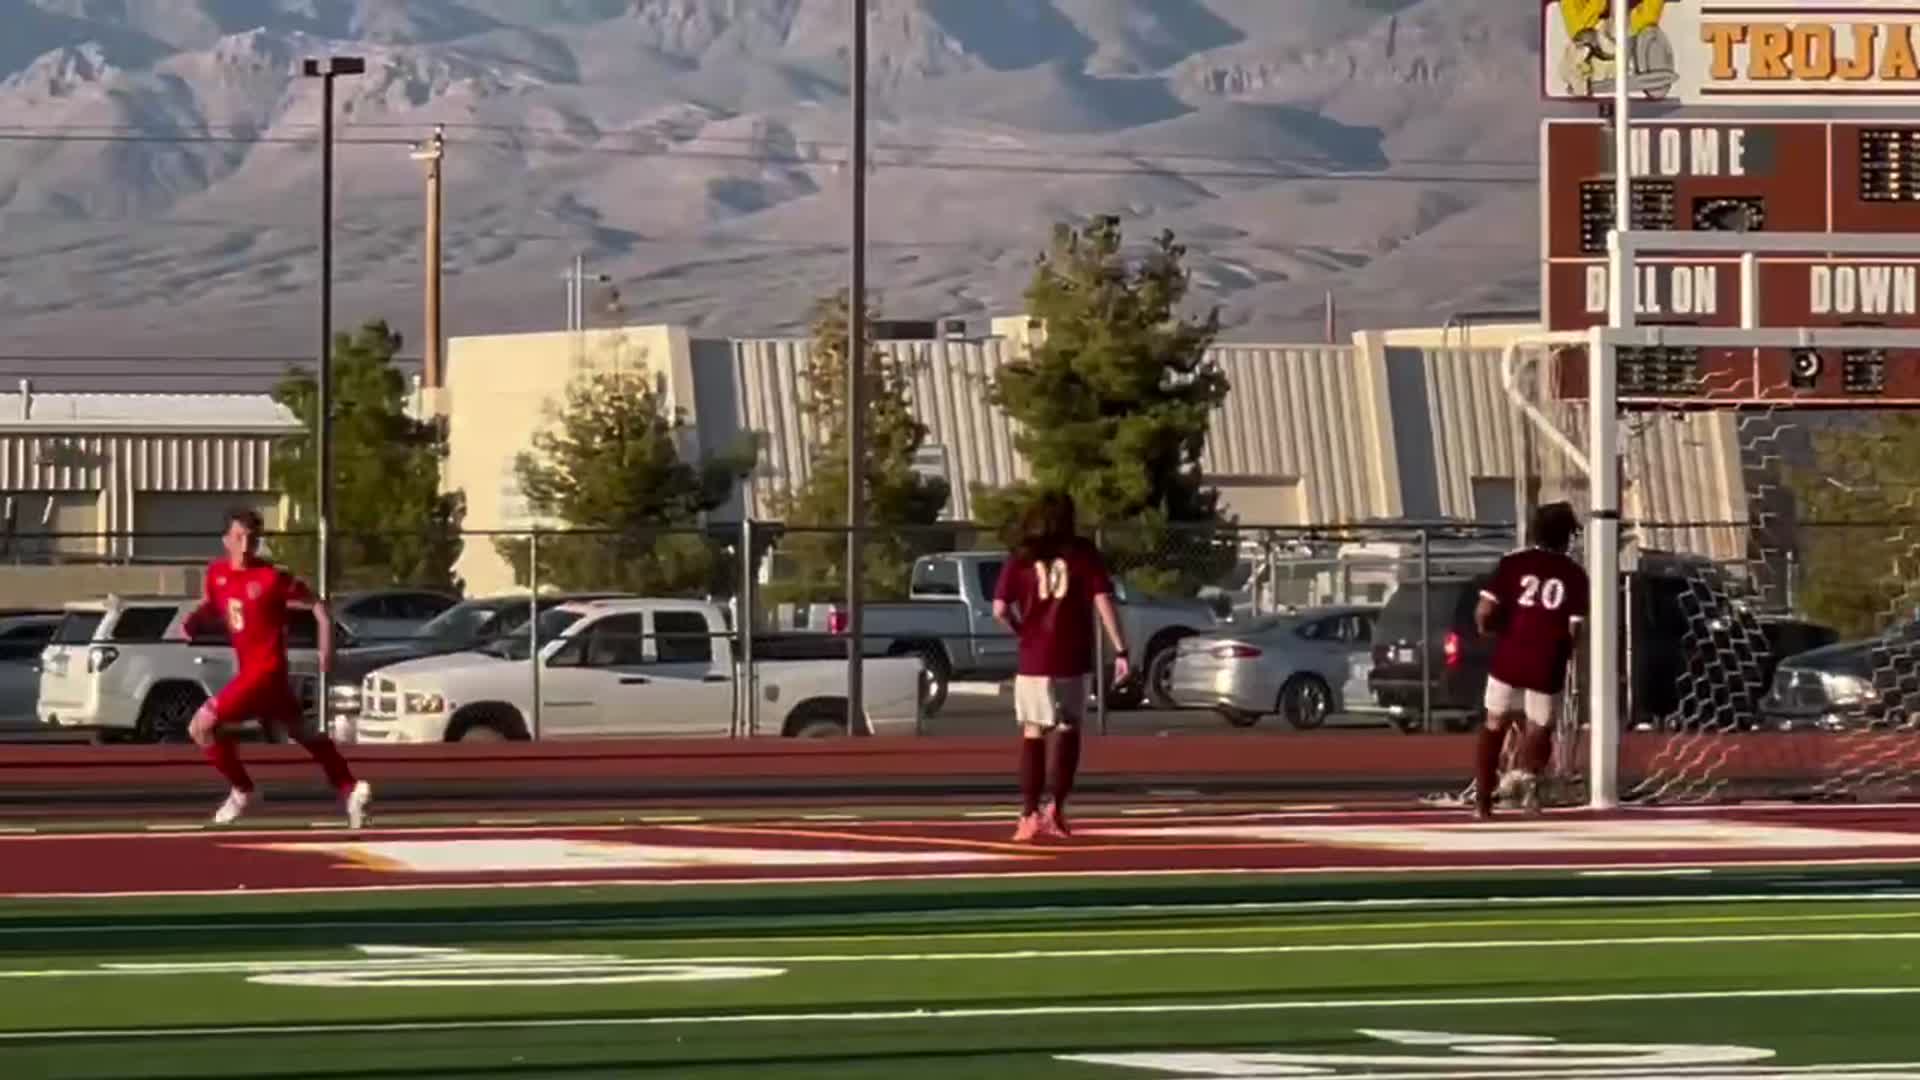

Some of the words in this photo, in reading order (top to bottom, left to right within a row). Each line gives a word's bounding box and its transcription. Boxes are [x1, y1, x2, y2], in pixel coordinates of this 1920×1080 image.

[1702, 23, 1920, 80] TROJA
[1630, 128, 1745, 176] HOME
[1586, 265, 1660, 313] BLL
[1671, 266, 1716, 314] ON
[1810, 265, 1916, 313] DOWN
[1517, 574, 1564, 610] 20
